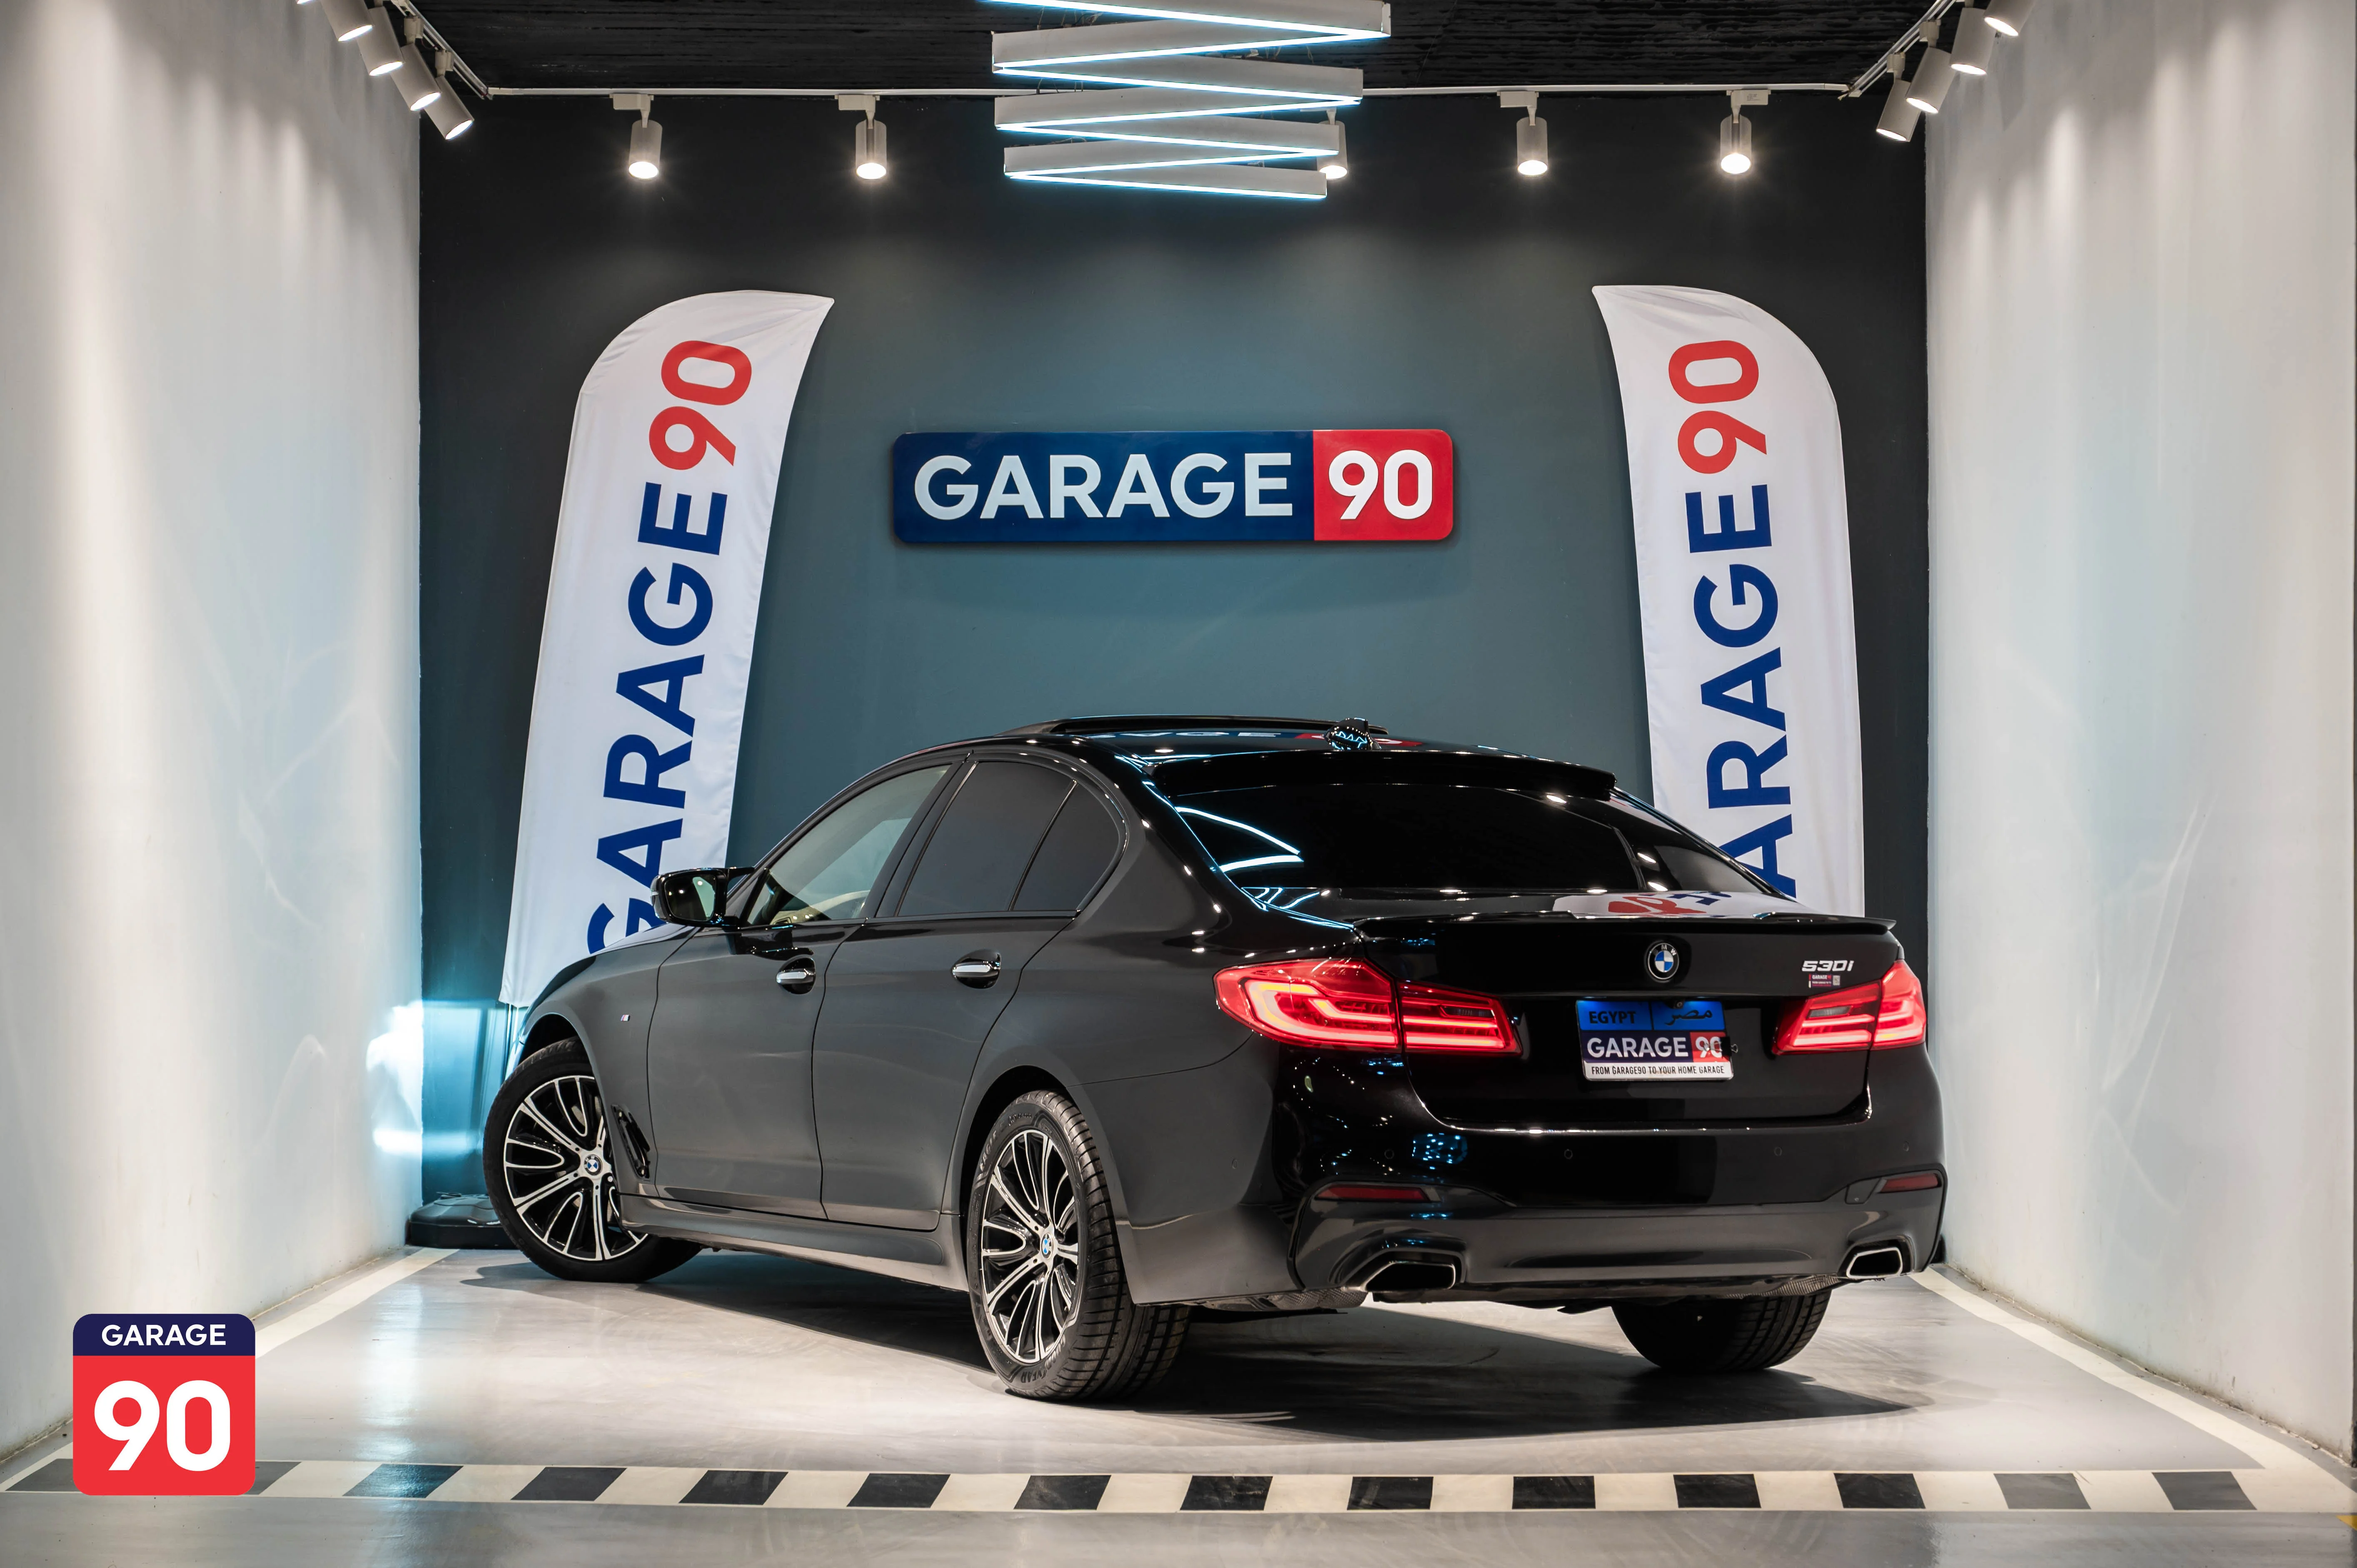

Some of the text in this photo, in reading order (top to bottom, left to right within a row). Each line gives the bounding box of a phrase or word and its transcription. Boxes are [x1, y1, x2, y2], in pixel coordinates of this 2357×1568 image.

[915, 449, 1432, 520] GARAGE 90
[1686, 486, 1796, 898] ARAGE
[1589, 1011, 1636, 1024] EGYPT
[1664, 1008, 1713, 1026] مصر
[1587, 1037, 1689, 1058] GARAGE
[1591, 1066, 1610, 1075] FROM
[1612, 1066, 1646, 1074] GARAGE90
[1659, 1066, 1676, 1074] YOUR
